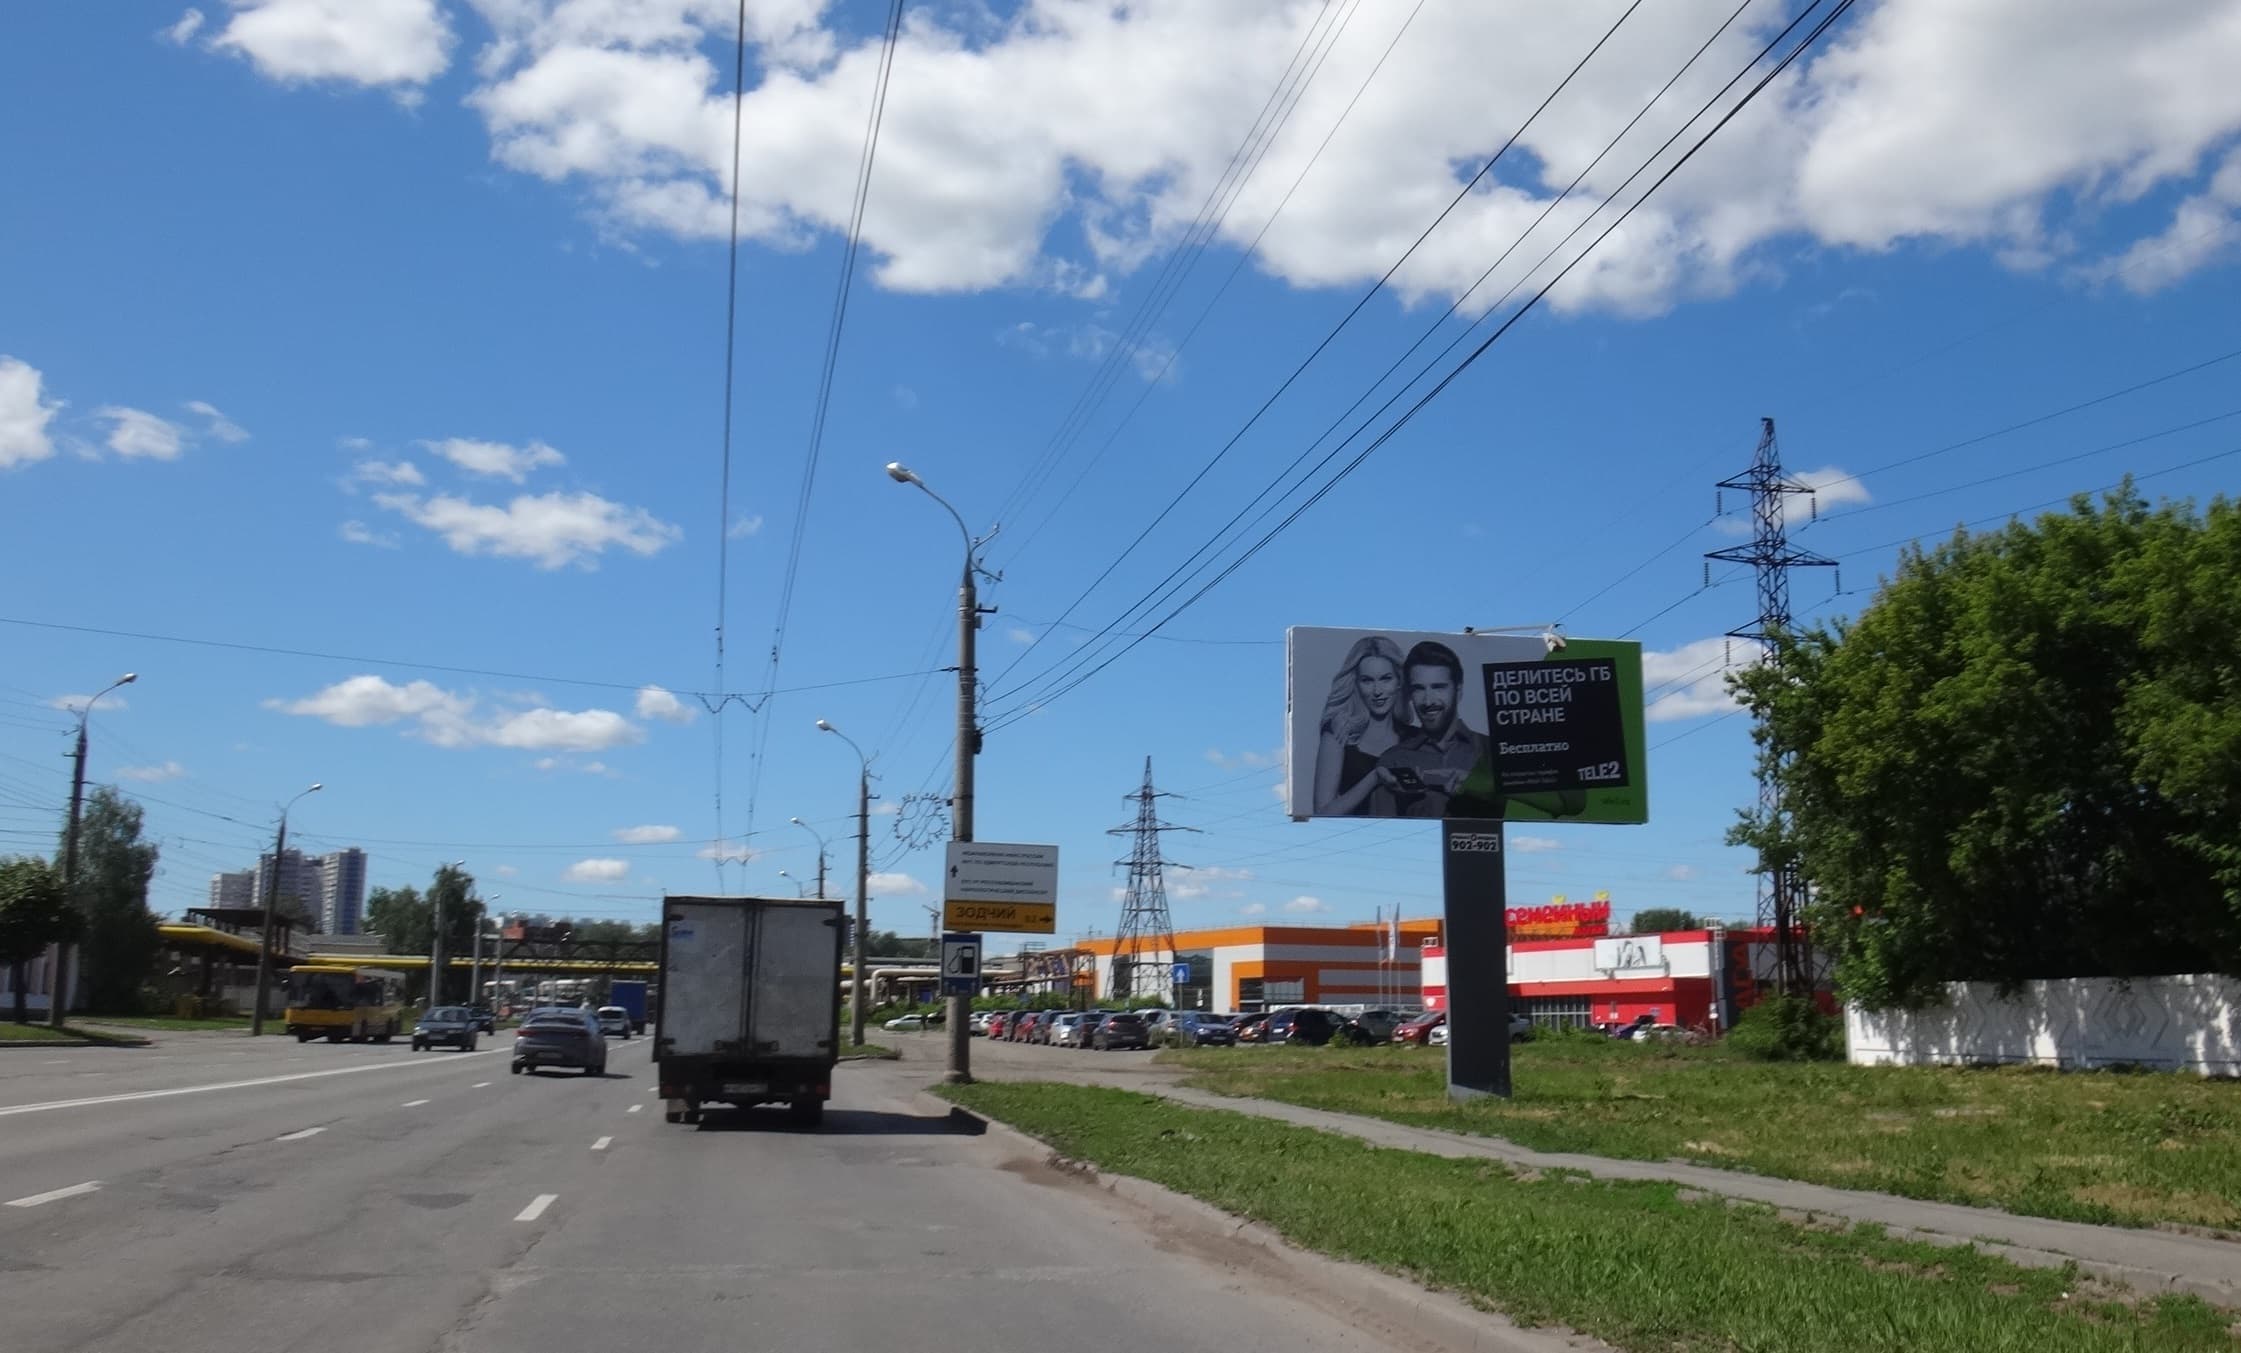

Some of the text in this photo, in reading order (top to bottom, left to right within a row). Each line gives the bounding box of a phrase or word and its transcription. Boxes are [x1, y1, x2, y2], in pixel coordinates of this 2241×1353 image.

[1492, 666, 1611, 689] ДЕЛИТЕСЬ ГБ
[1494, 684, 1573, 706] ПО ВСЕЙ
[1496, 707, 1566, 725] СТРАНЕ
[1499, 741, 1570, 755] Бесплатно
[1577, 761, 1621, 782] TELE2
[955, 906, 1017, 921] ЗОДЧИЙ
